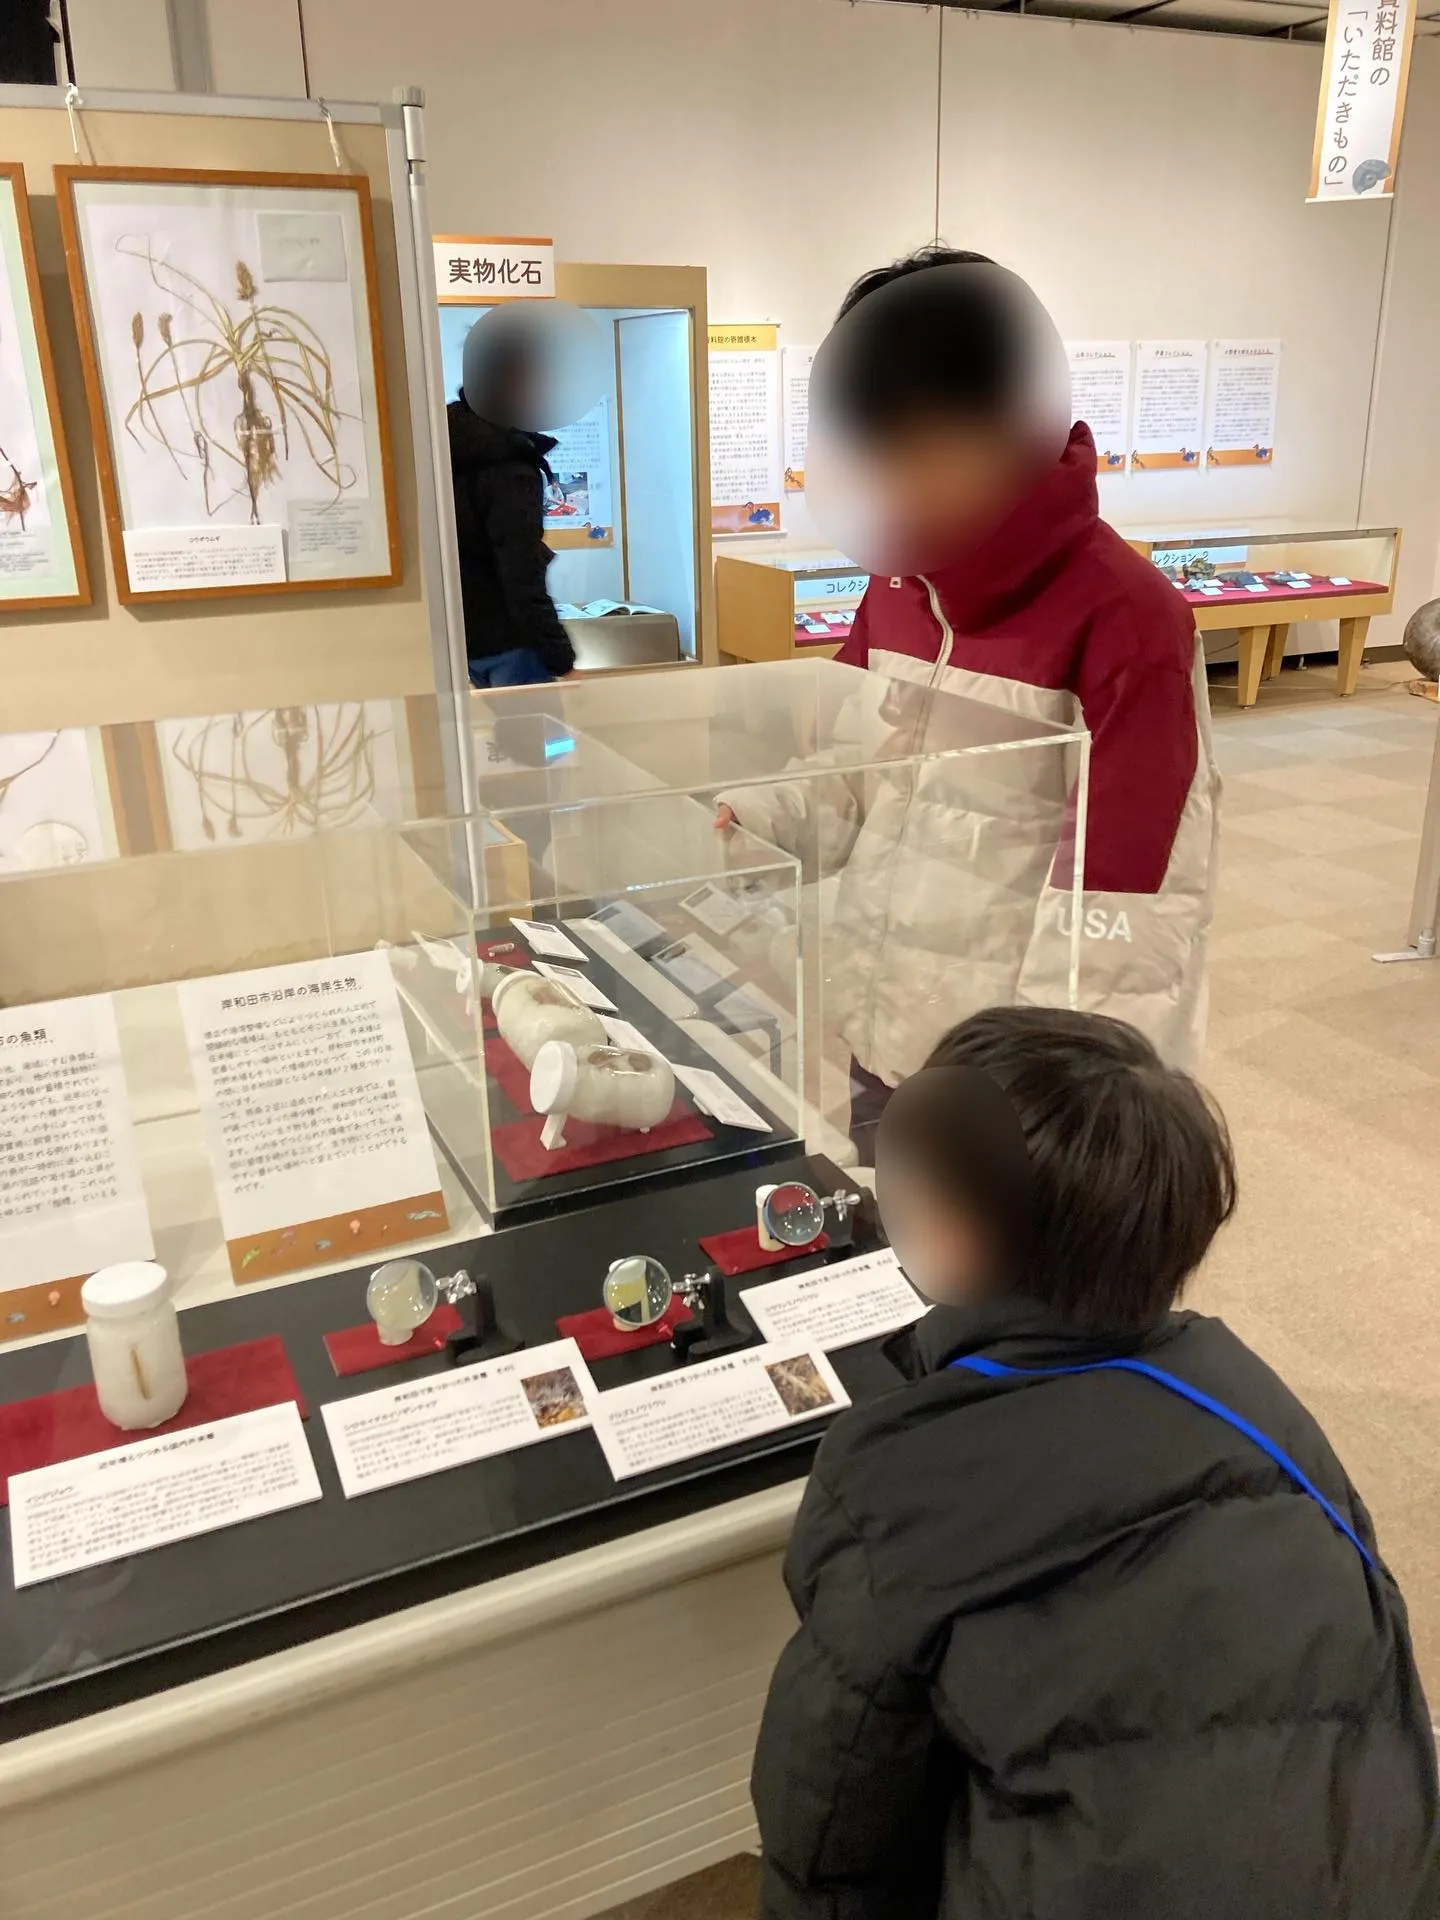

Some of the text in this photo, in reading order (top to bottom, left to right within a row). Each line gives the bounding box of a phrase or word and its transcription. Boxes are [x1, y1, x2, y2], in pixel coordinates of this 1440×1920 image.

[1324, 10, 1369, 186] 「いただきもの」
[449, 257, 542, 284] 実物化石
[1056, 908, 1133, 943] USA
[221, 976, 357, 1010] 岸和田市沿岸の海岸生物
